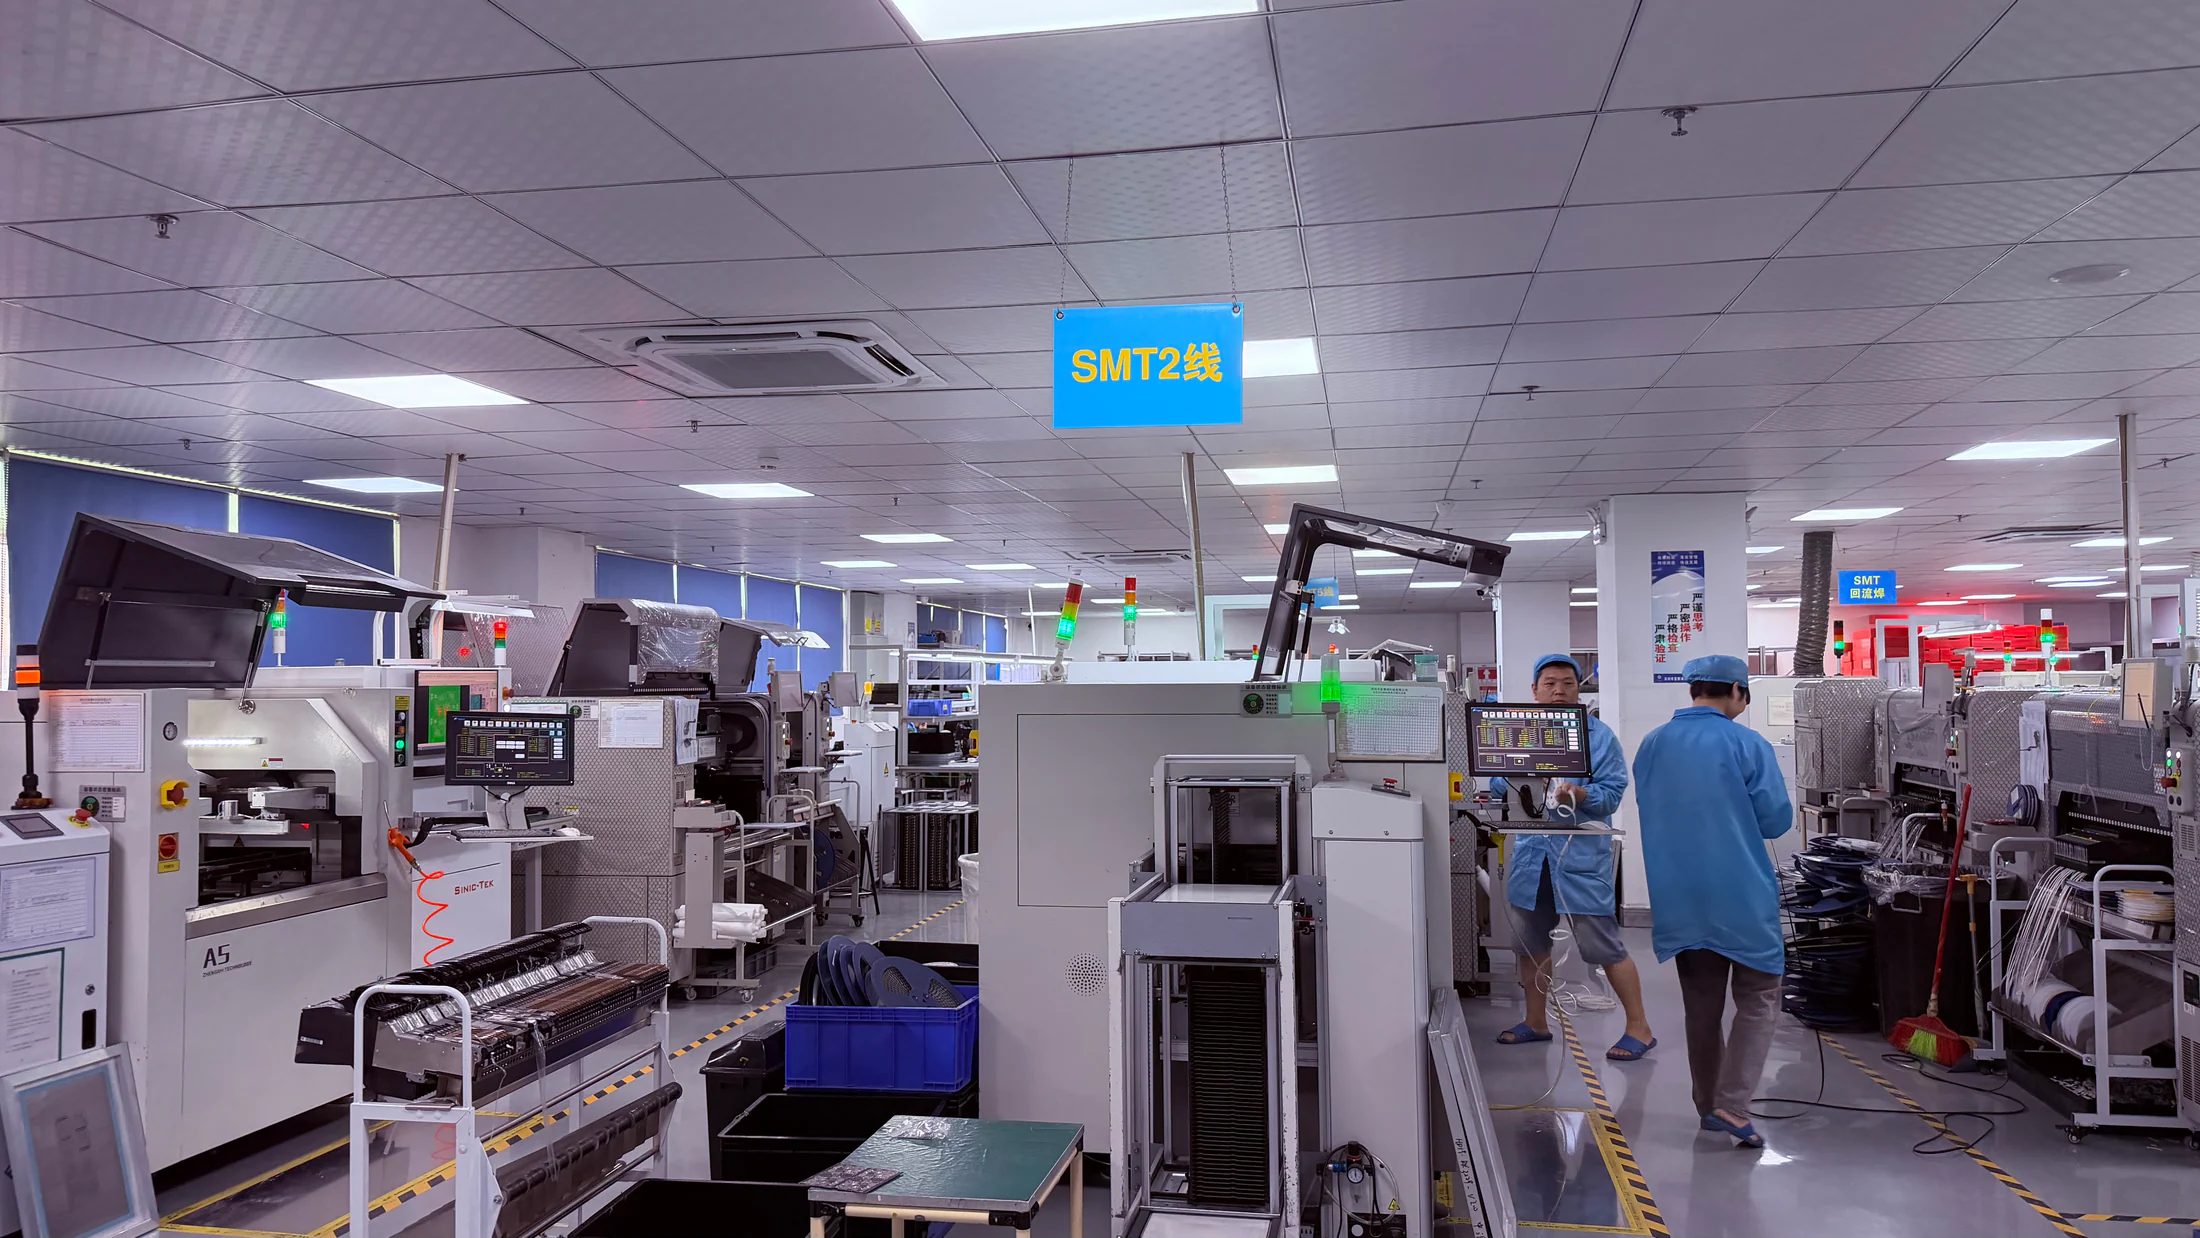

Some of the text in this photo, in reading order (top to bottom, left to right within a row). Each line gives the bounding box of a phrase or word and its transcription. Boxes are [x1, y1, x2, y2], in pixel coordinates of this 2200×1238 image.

[1071, 342, 1223, 382] SMT2线
[1850, 588, 1885, 599] 回流焊
[1853, 575, 1881, 585] SMT
[1680, 603, 1691, 642] 严密操作
[1692, 592, 1704, 632] 严谨思考
[1655, 624, 1666, 663] 严肃验证
[1667, 613, 1679, 653] 严格检查
[203, 943, 231, 969] A5
[224, 960, 252, 972] TECHNOLOGY
